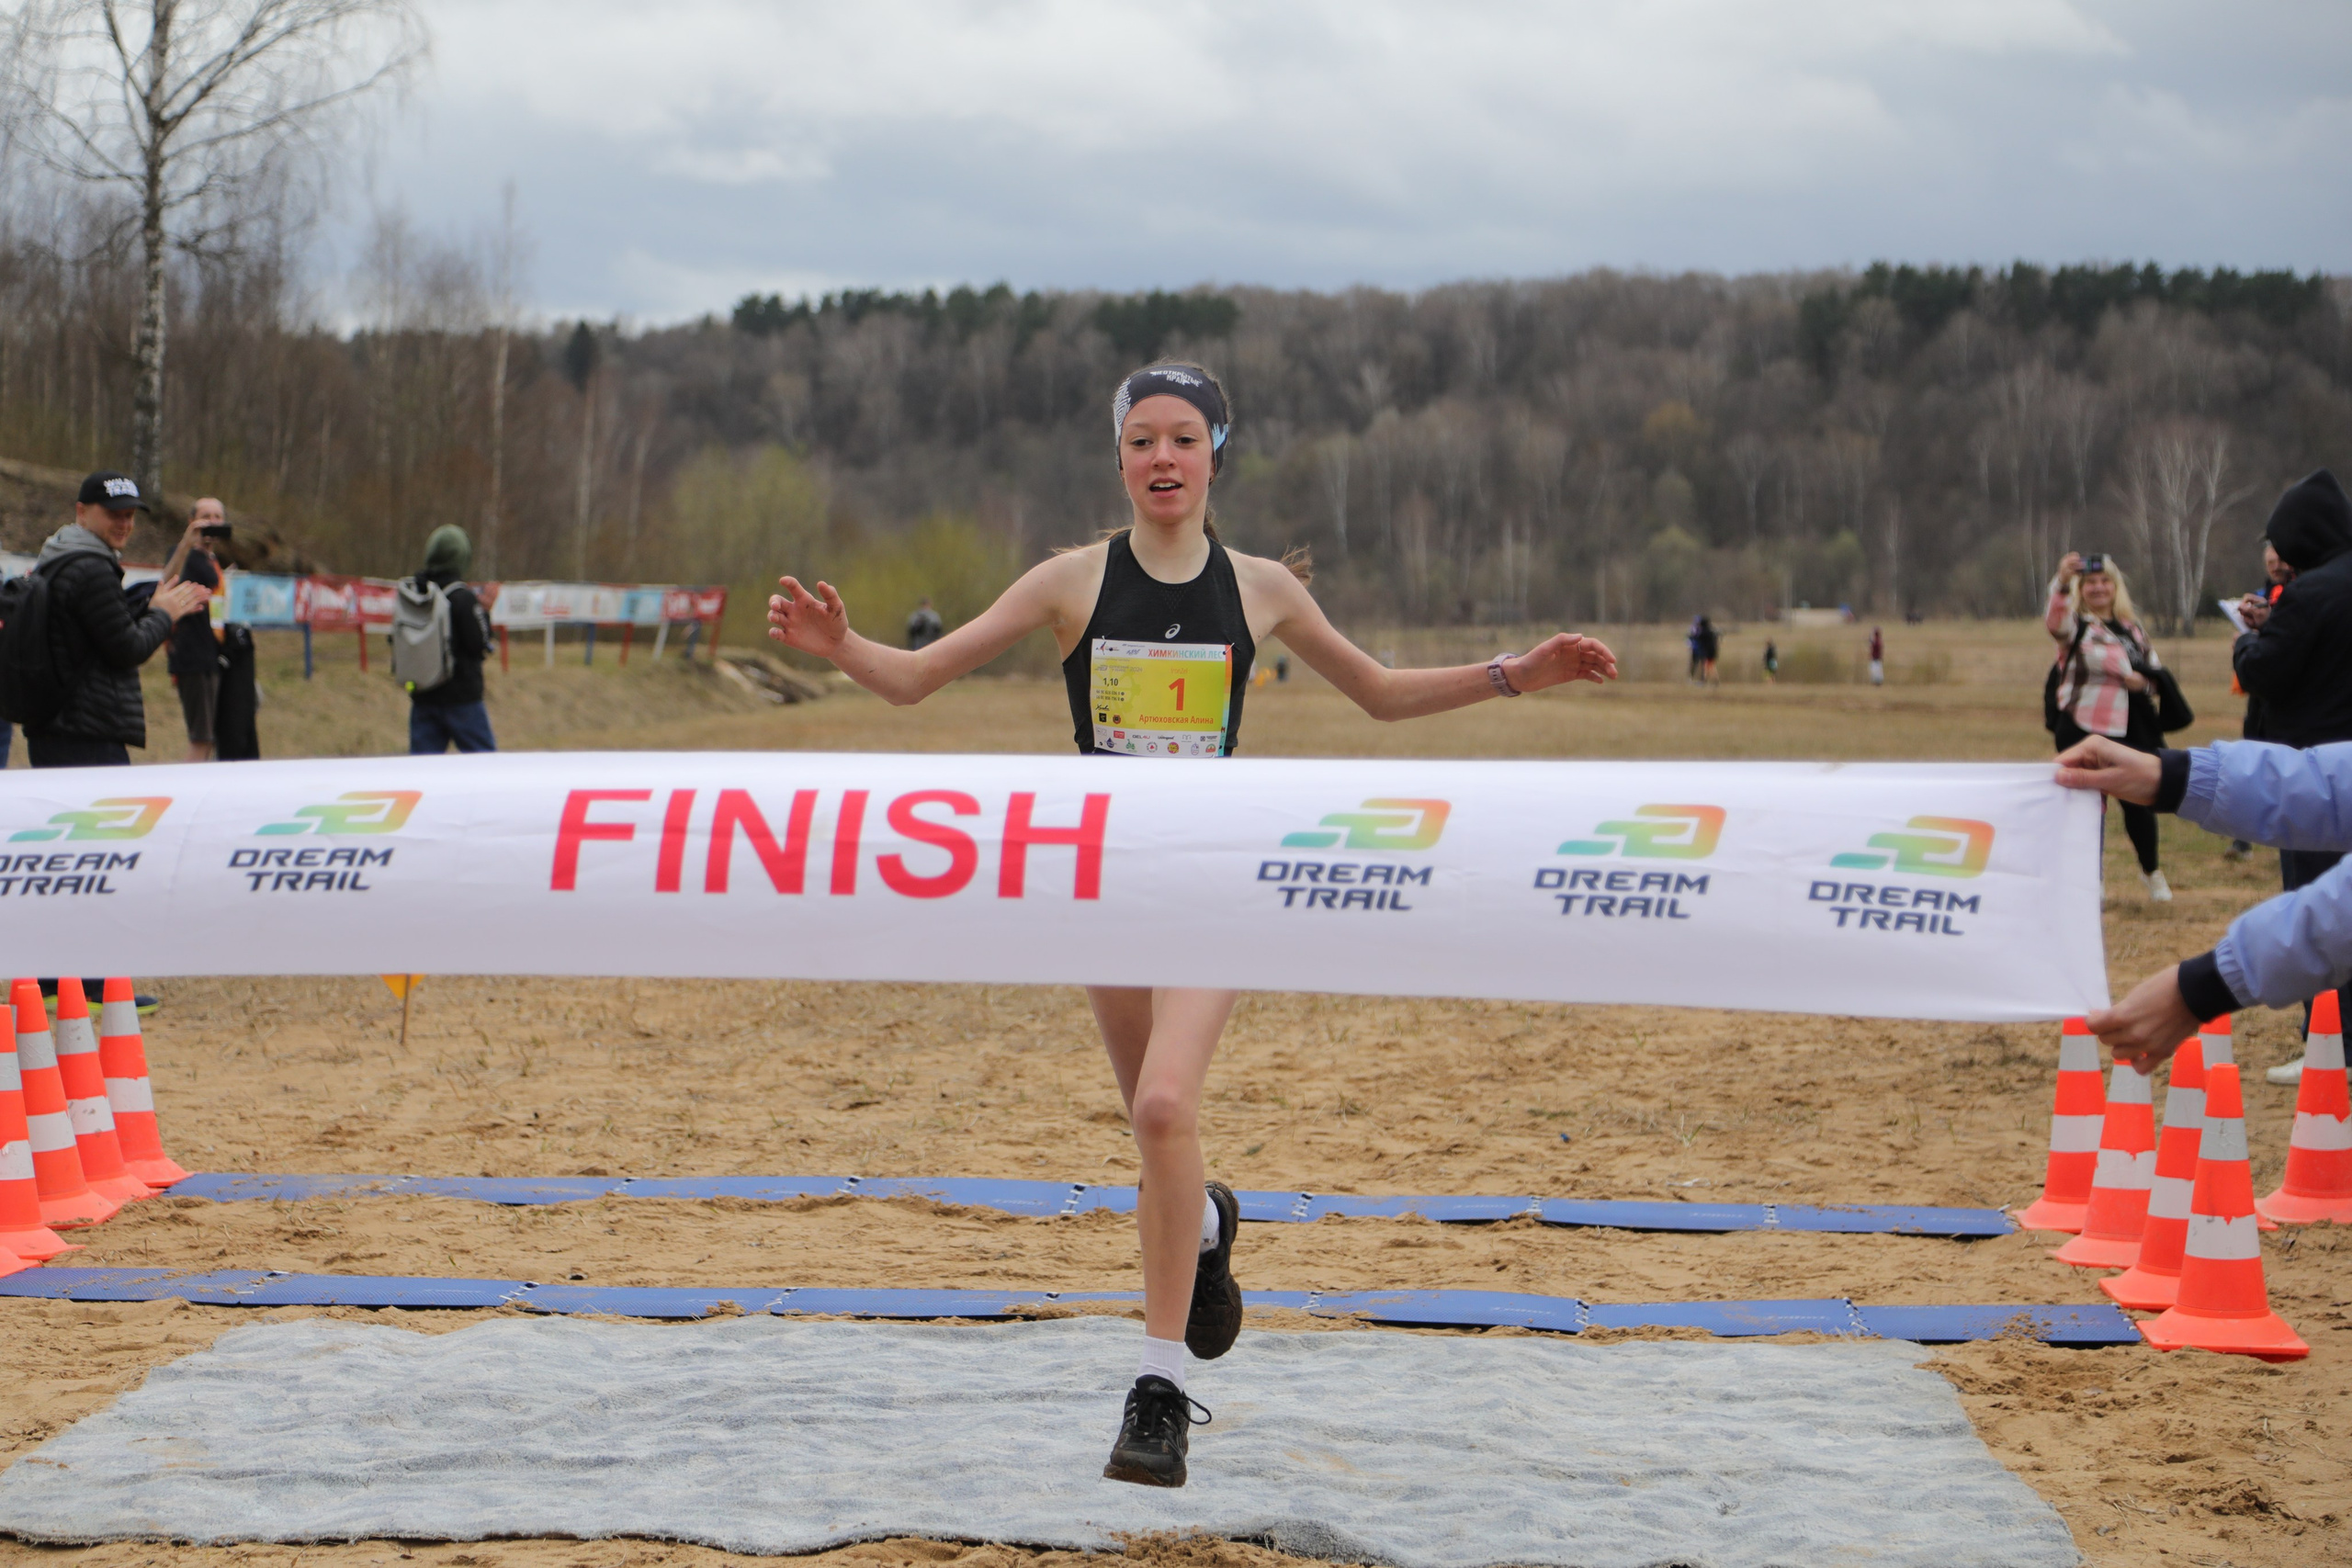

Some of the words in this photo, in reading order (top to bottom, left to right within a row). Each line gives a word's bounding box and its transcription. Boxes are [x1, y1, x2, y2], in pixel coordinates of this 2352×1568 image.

[1148, 648, 1206, 659] ХИМКИНСКИЙ
[1207, 649, 1223, 660] ЛЕС
[1102, 677, 1119, 687] 1,10
[1169, 678, 1185, 711] 1
[1138, 713, 1189, 725] Артюховская
[1190, 716, 1214, 725] Алина
[550, 789, 1112, 901] FINISH
[228, 848, 395, 868] DREAM
[0, 874, 116, 897] TRAIL
[246, 870, 370, 892] TRAIL
[1257, 861, 1433, 886] DREAM
[1533, 868, 1711, 895] DREAM
[1277, 886, 1414, 911] TRAIL
[1555, 894, 1690, 919] TRAIL
[1808, 880, 1981, 914] DREAM
[1828, 907, 1965, 936] TRAIL
